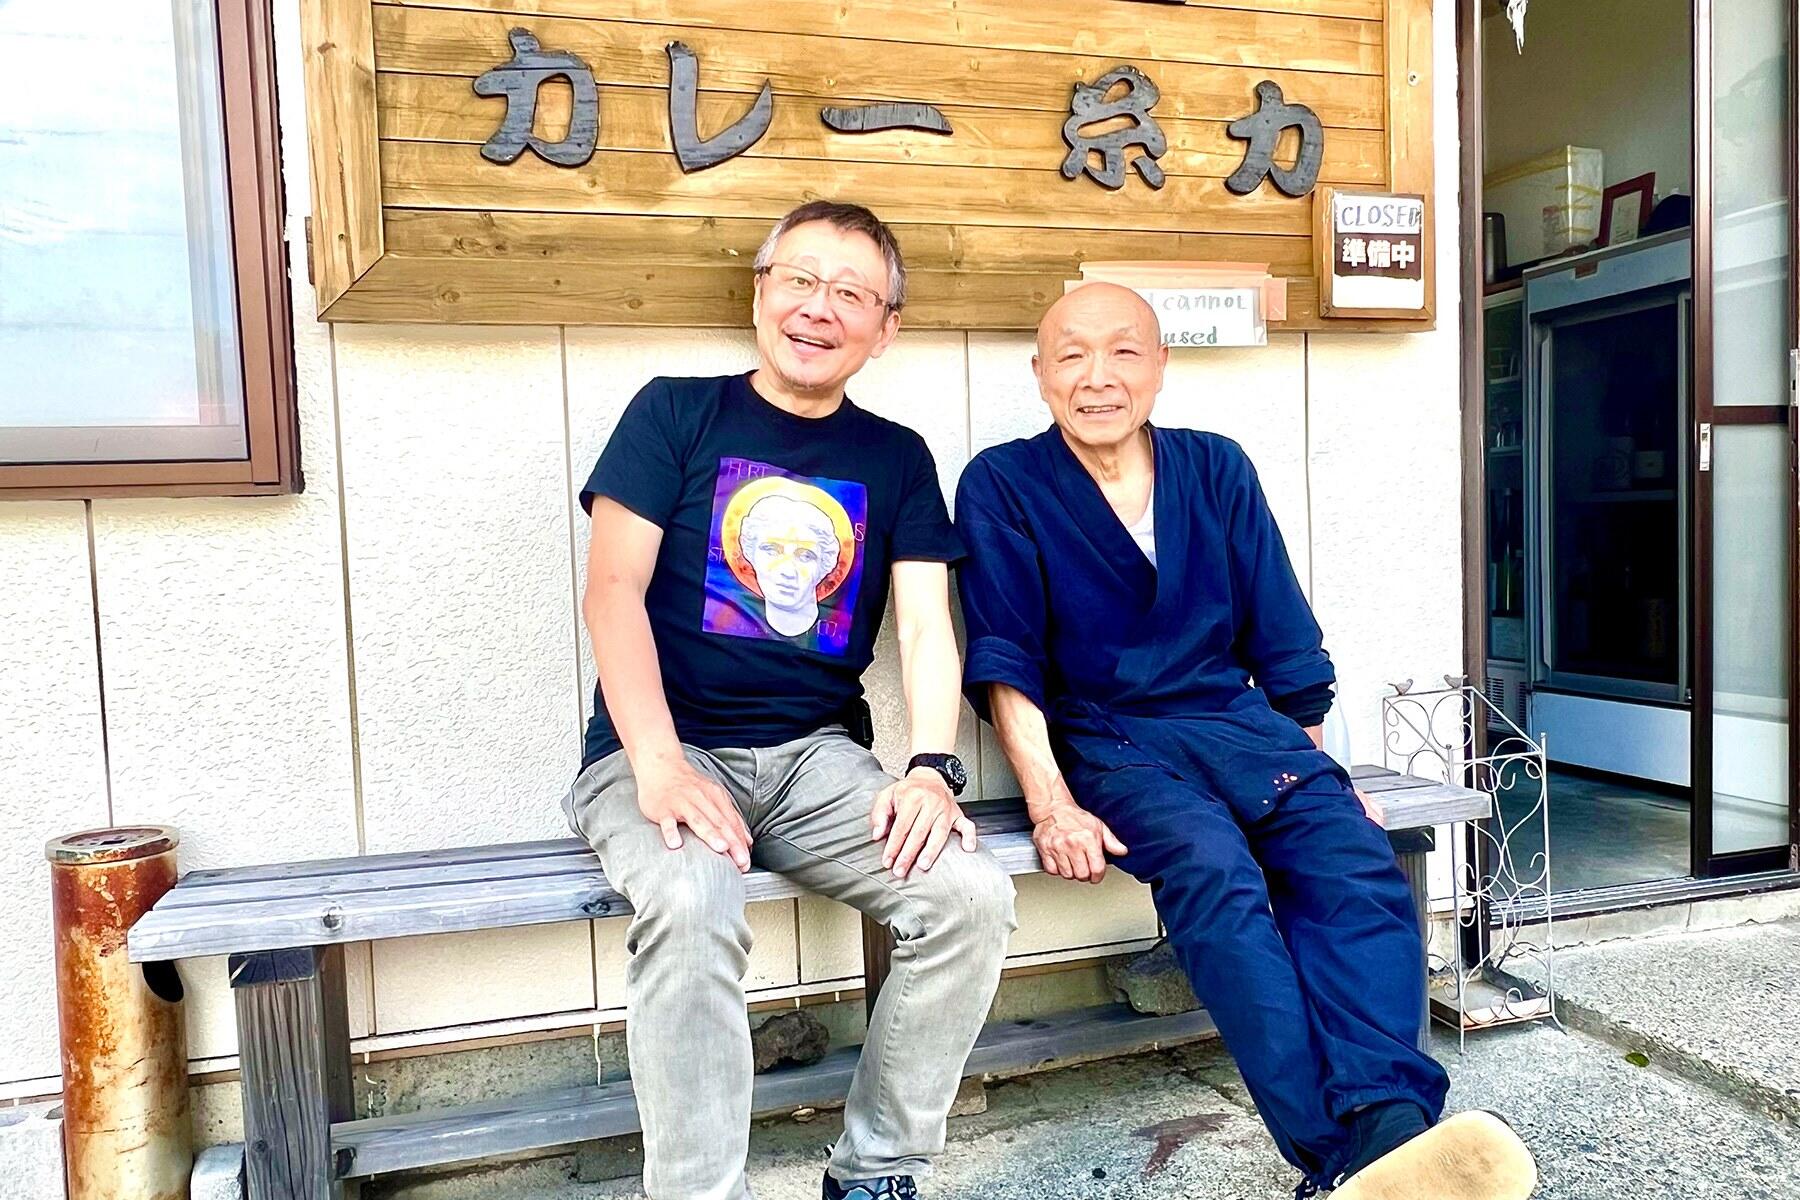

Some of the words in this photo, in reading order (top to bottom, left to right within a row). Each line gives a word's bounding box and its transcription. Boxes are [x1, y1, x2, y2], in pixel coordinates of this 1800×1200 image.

[474, 26, 953, 174] カレー
[1341, 204, 1420, 227] CLOSED
[1342, 237, 1415, 269] 準備中
[1163, 325, 1217, 345] used
